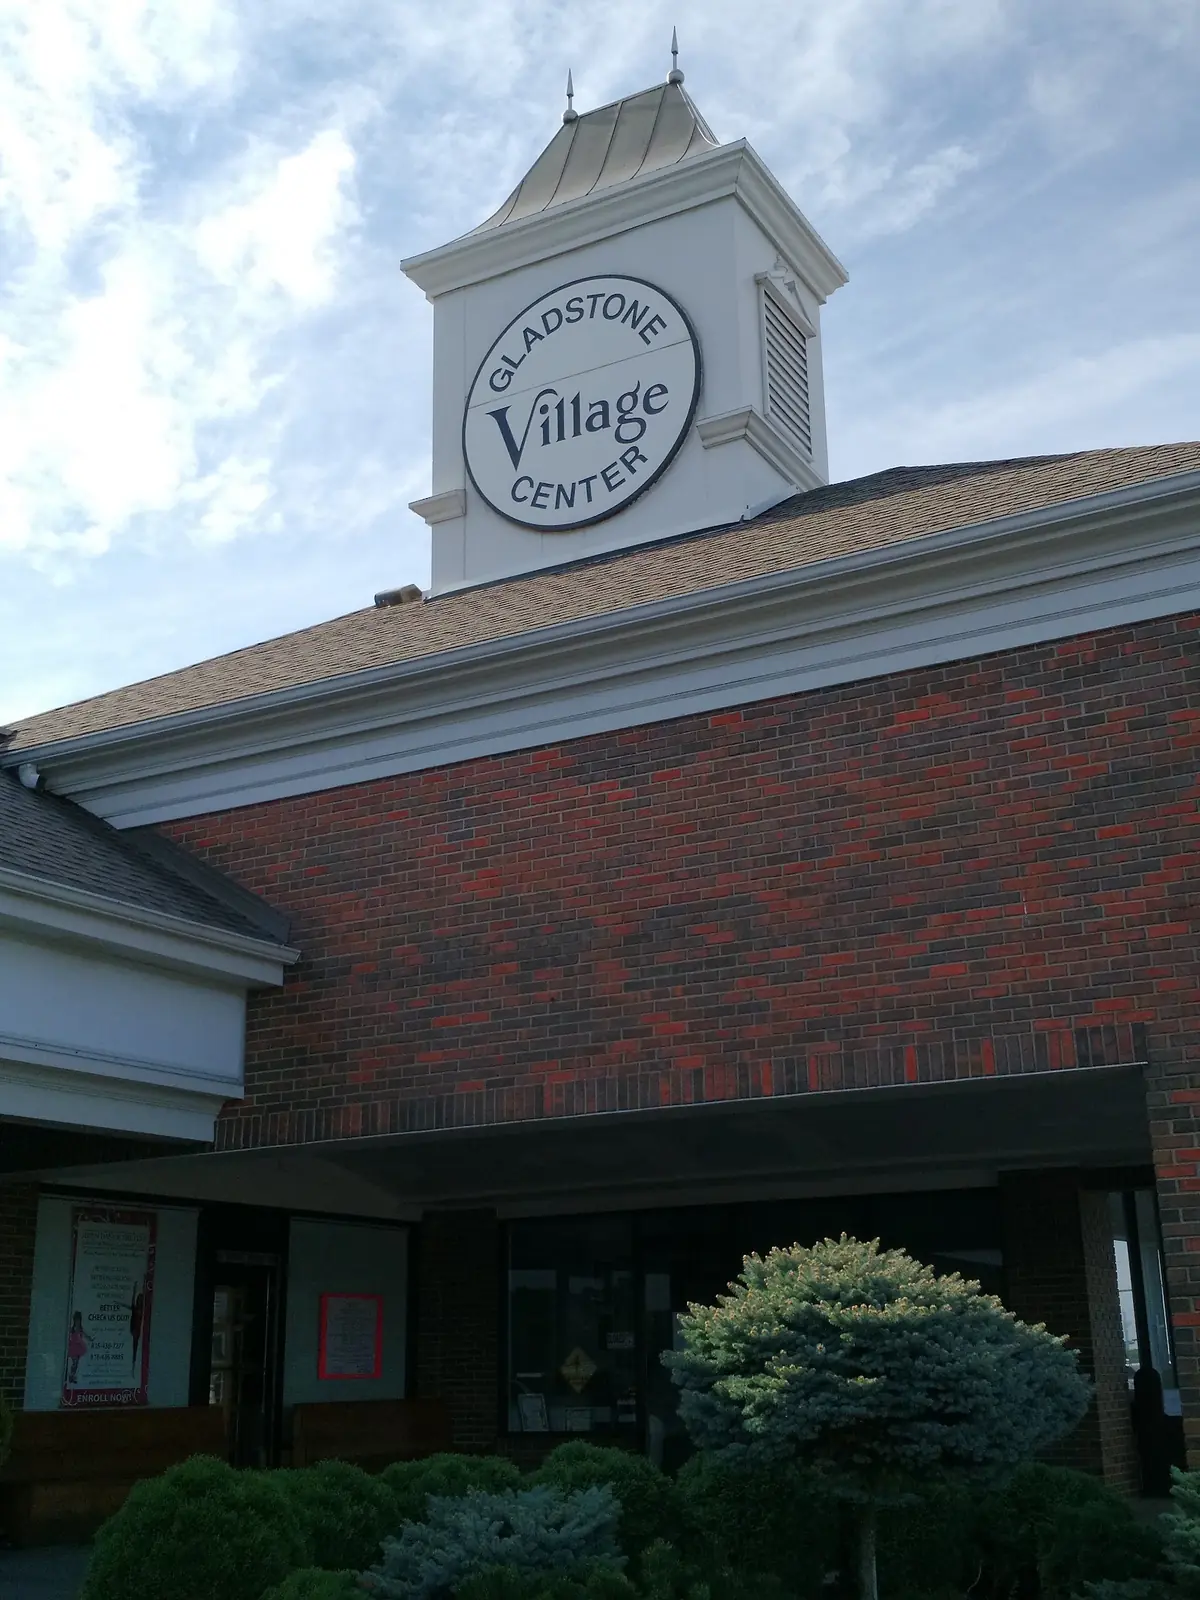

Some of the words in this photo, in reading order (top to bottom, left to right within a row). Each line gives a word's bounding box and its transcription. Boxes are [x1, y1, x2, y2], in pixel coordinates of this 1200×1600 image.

[489, 292, 668, 393] GLADSTONE
[485, 380, 669, 472] Village
[511, 445, 649, 510] CENTER
[77, 1393, 108, 1403] ENROLL
